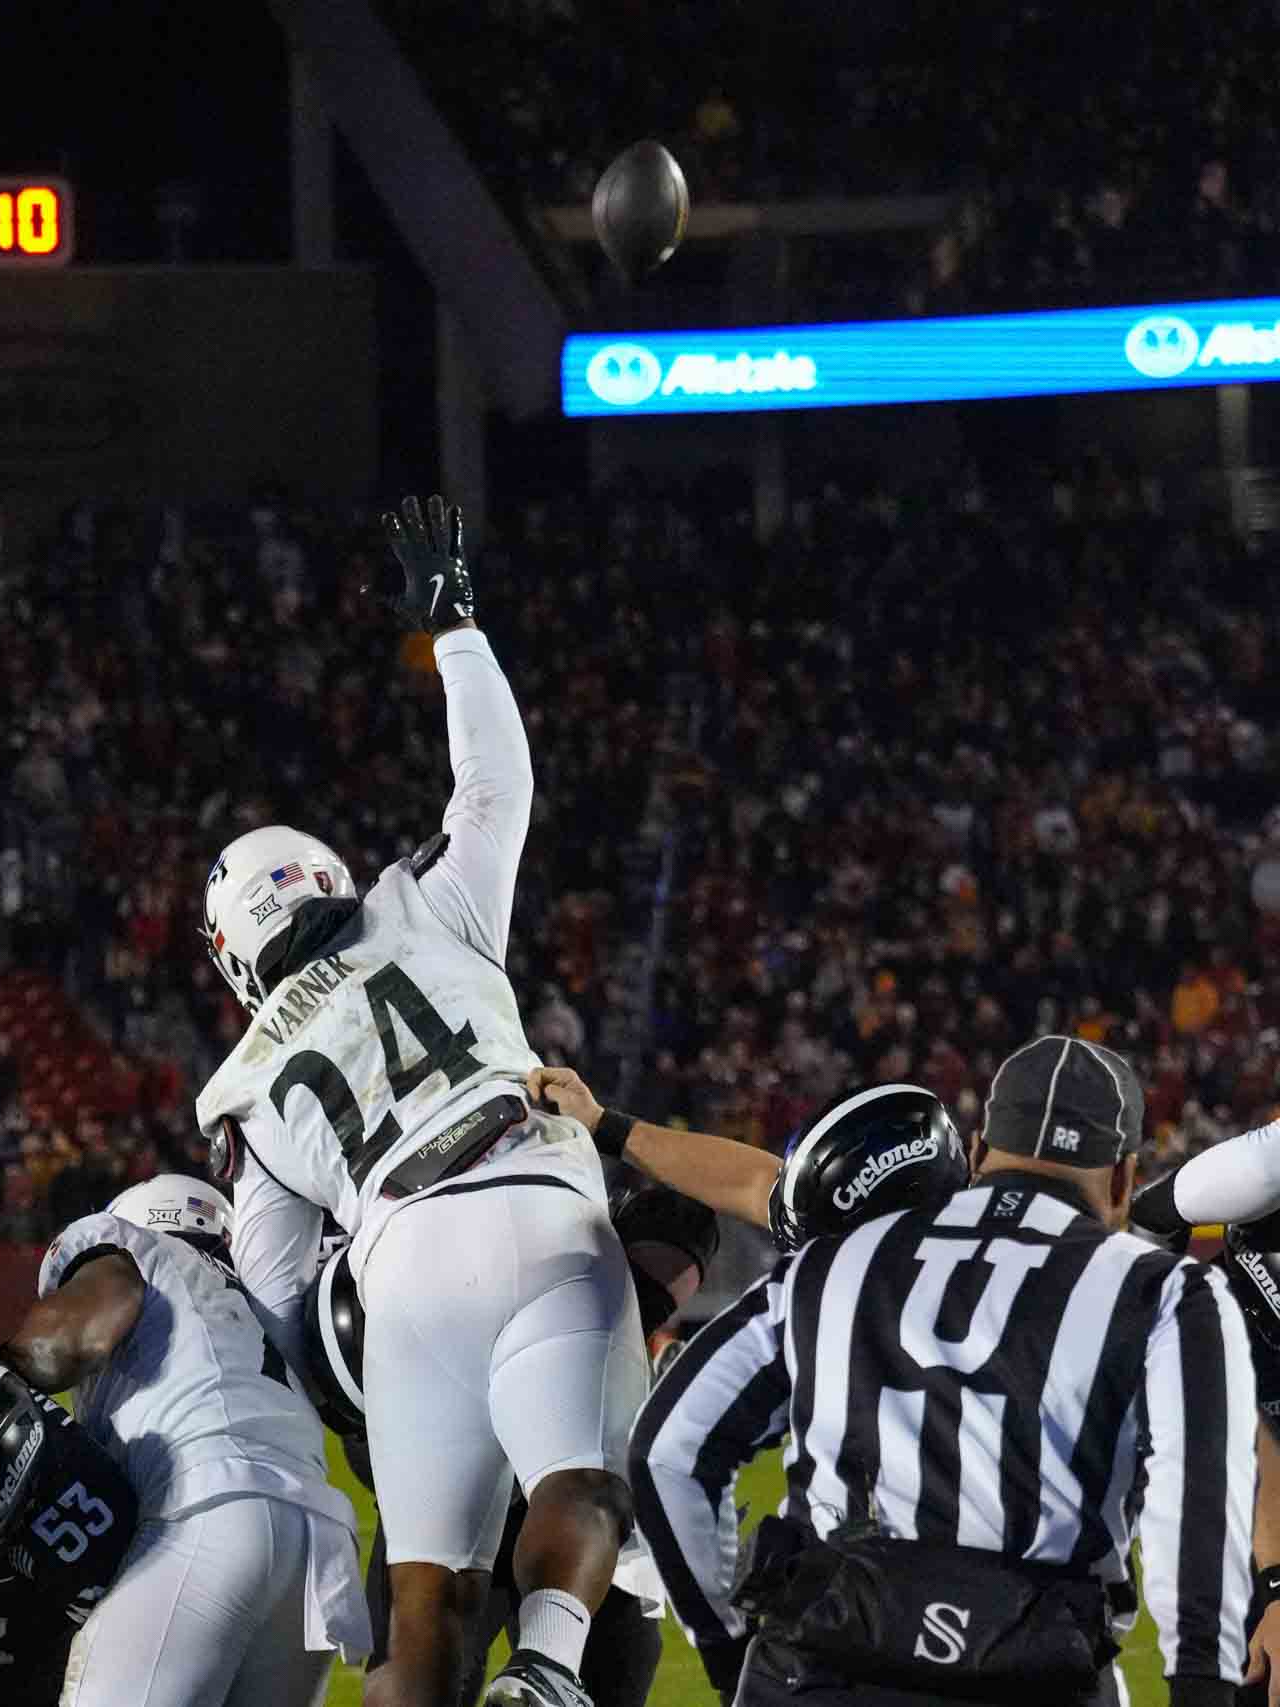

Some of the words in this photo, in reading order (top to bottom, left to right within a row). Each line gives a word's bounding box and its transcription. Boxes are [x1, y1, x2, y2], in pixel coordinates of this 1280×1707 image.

[661, 351, 817, 396] Allstate
[262, 952, 356, 1045] VARNER
[268, 960, 488, 1197] 24
[832, 1136, 939, 1211] Cyclones
[1051, 1125, 1081, 1153] RR
[899, 1237, 1053, 1375] U
[31, 1481, 115, 1563] 53
[913, 1602, 971, 1664] S
